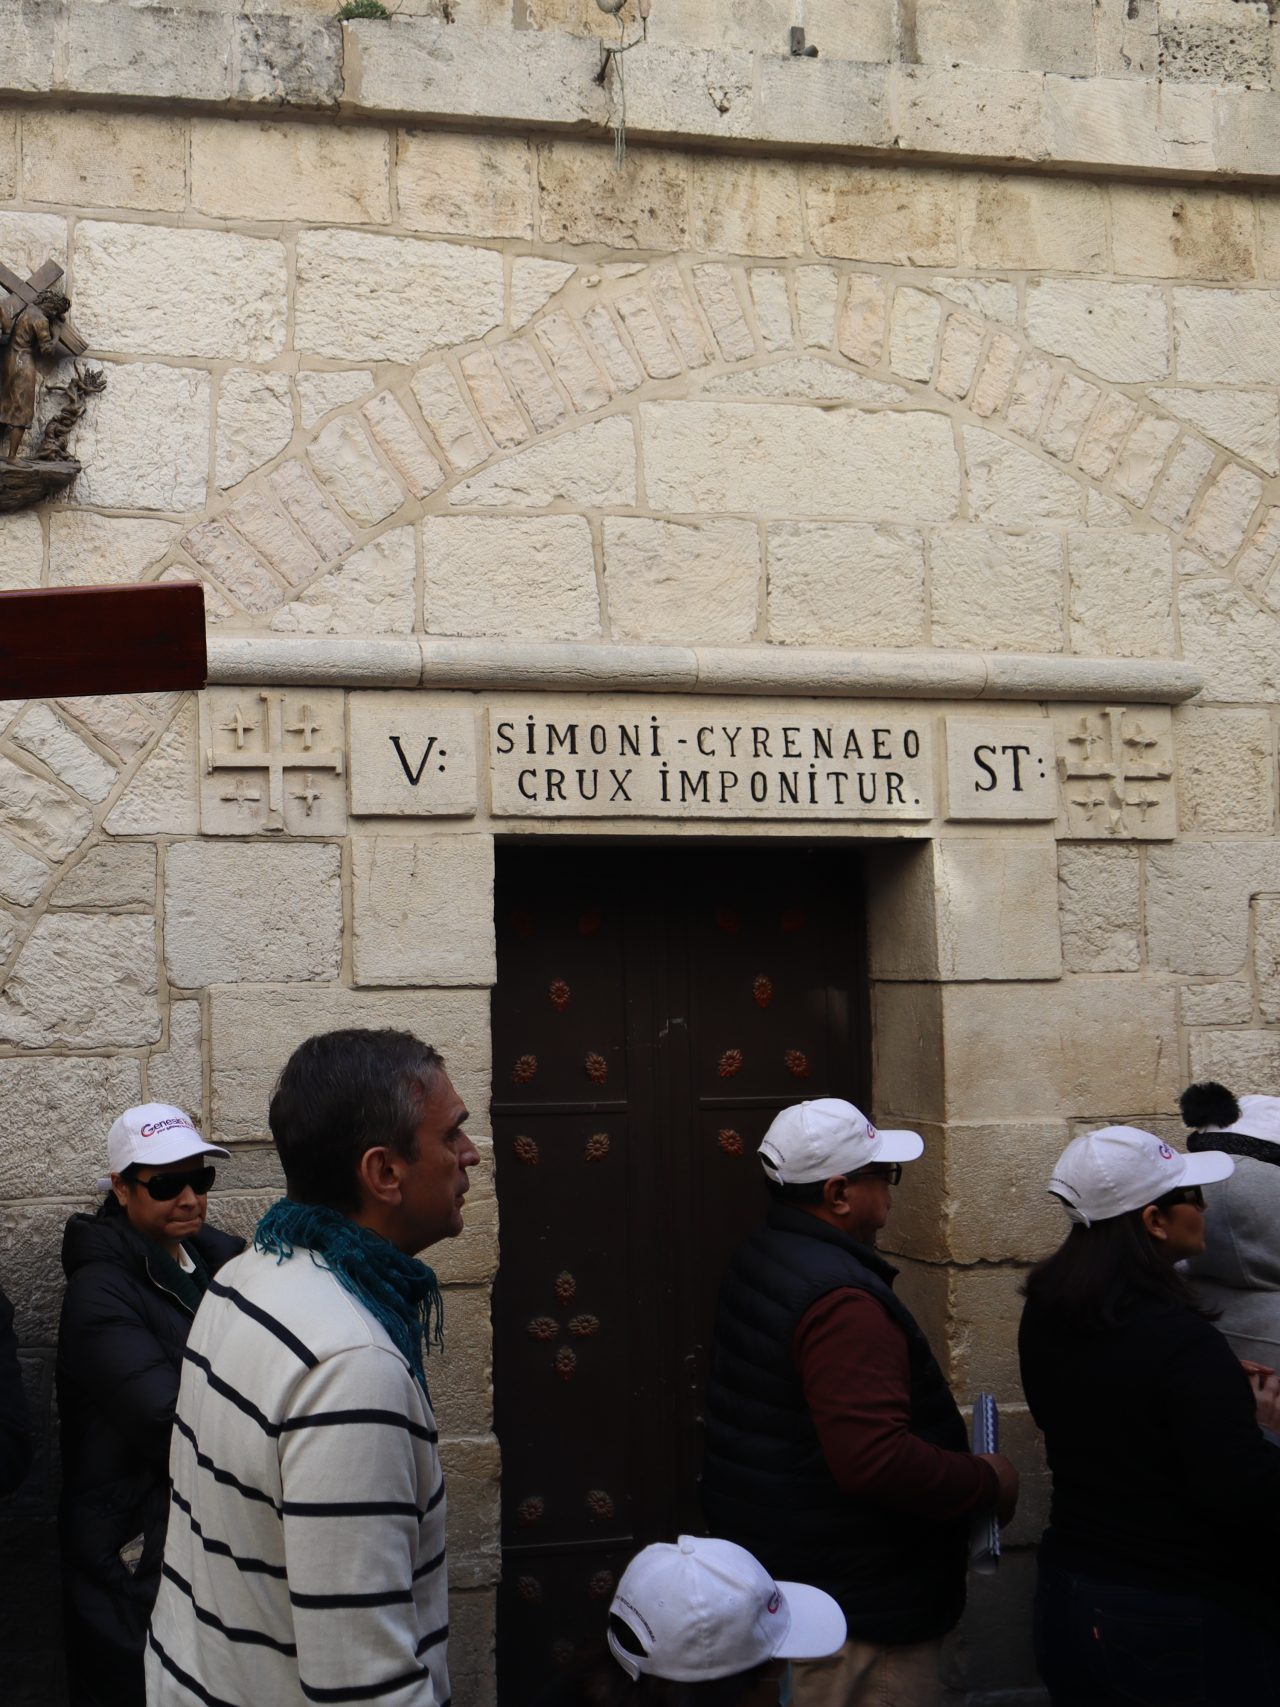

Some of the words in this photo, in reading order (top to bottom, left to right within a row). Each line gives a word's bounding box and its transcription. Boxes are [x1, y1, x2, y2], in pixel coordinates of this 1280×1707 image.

[388, 735, 447, 786] V:
[517, 767, 634, 802] CRUX
[973, 744, 1046, 792] ST:
